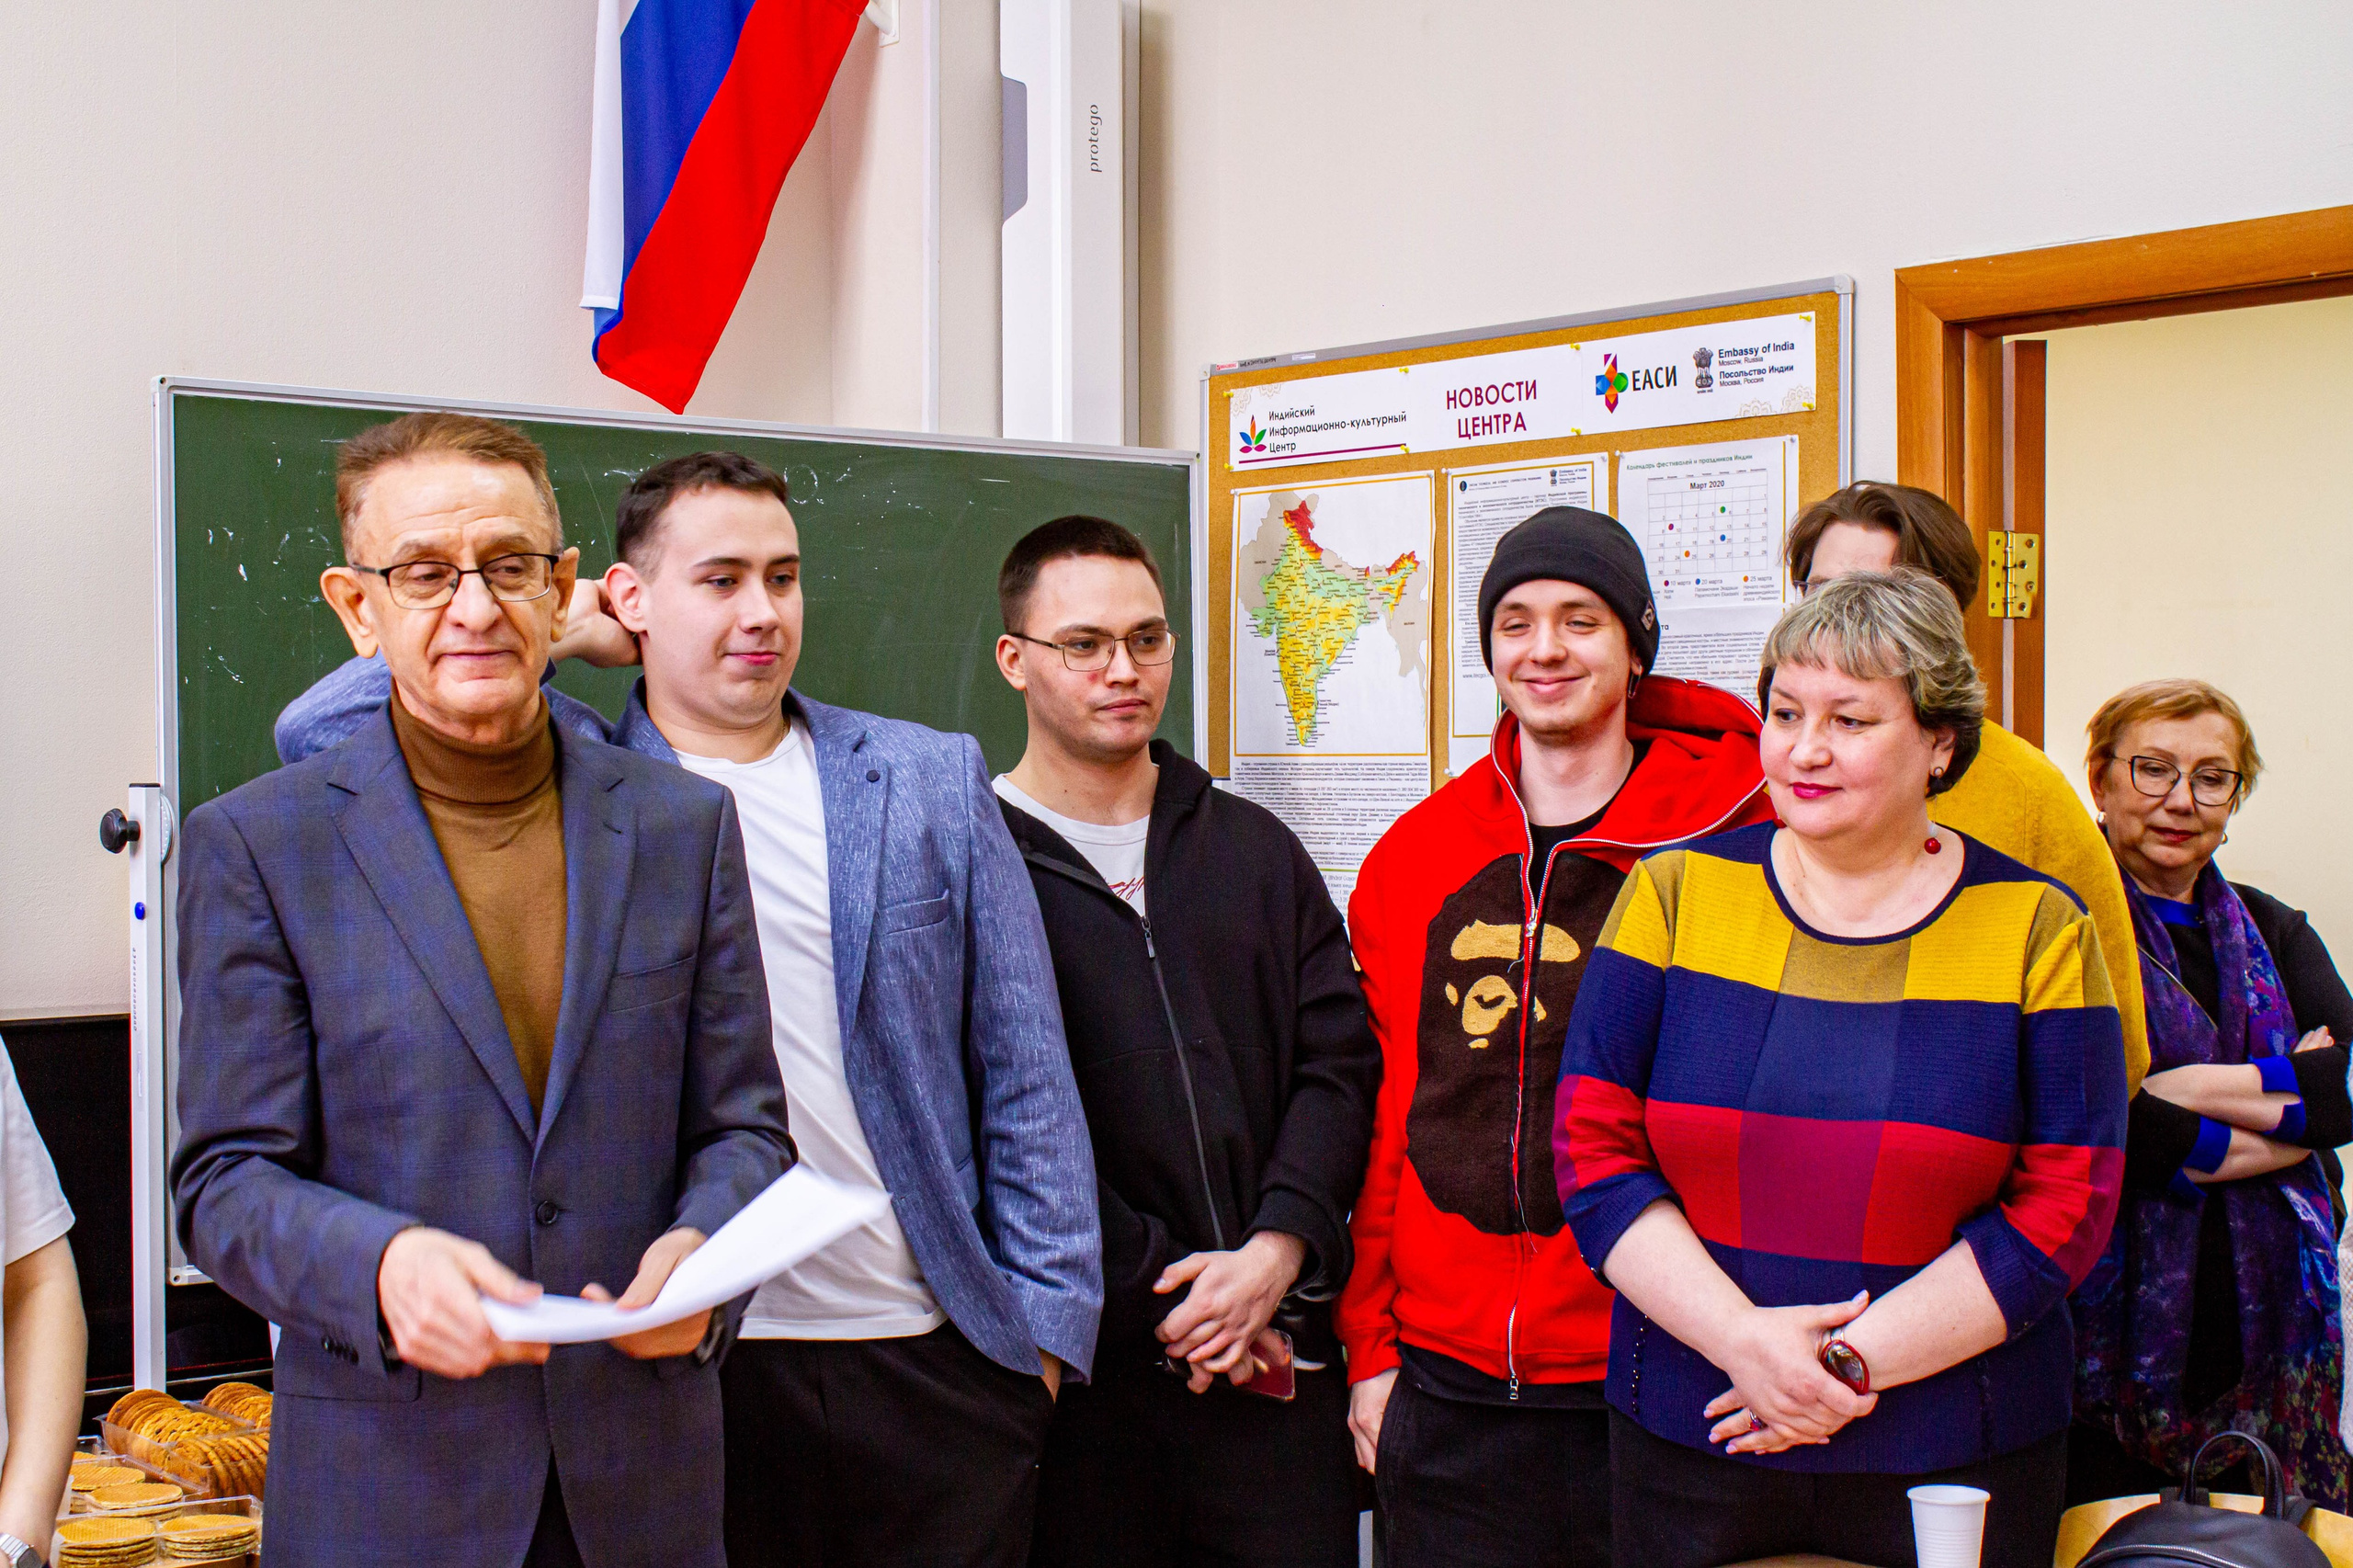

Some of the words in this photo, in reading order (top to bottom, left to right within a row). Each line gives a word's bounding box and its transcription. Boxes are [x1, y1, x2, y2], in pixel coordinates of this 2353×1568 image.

[1088, 104, 1103, 173] protego
[1718, 345, 1759, 358] Embassy
[1761, 344, 1771, 355] of
[1772, 341, 1795, 353] India
[1744, 356, 1764, 364] Russia
[1631, 365, 1677, 392] ЕАСИ
[1719, 368, 1767, 381] Посольство
[1768, 364, 1794, 376] Индии
[1743, 376, 1765, 385] Россия
[1446, 379, 1538, 411] НОВОСТИ
[1268, 405, 1315, 422] Индийский
[1268, 412, 1407, 438] Информационно-культурный
[1458, 412, 1528, 440] ЦЕНТРА
[1269, 441, 1297, 454] Центр
[1626, 462, 1655, 471] Календарь
[1655, 458, 1693, 468] фестивалей
[1699, 455, 1733, 466] праздников
[1689, 482, 1708, 491] Март
[1709, 480, 1725, 488] 2020
